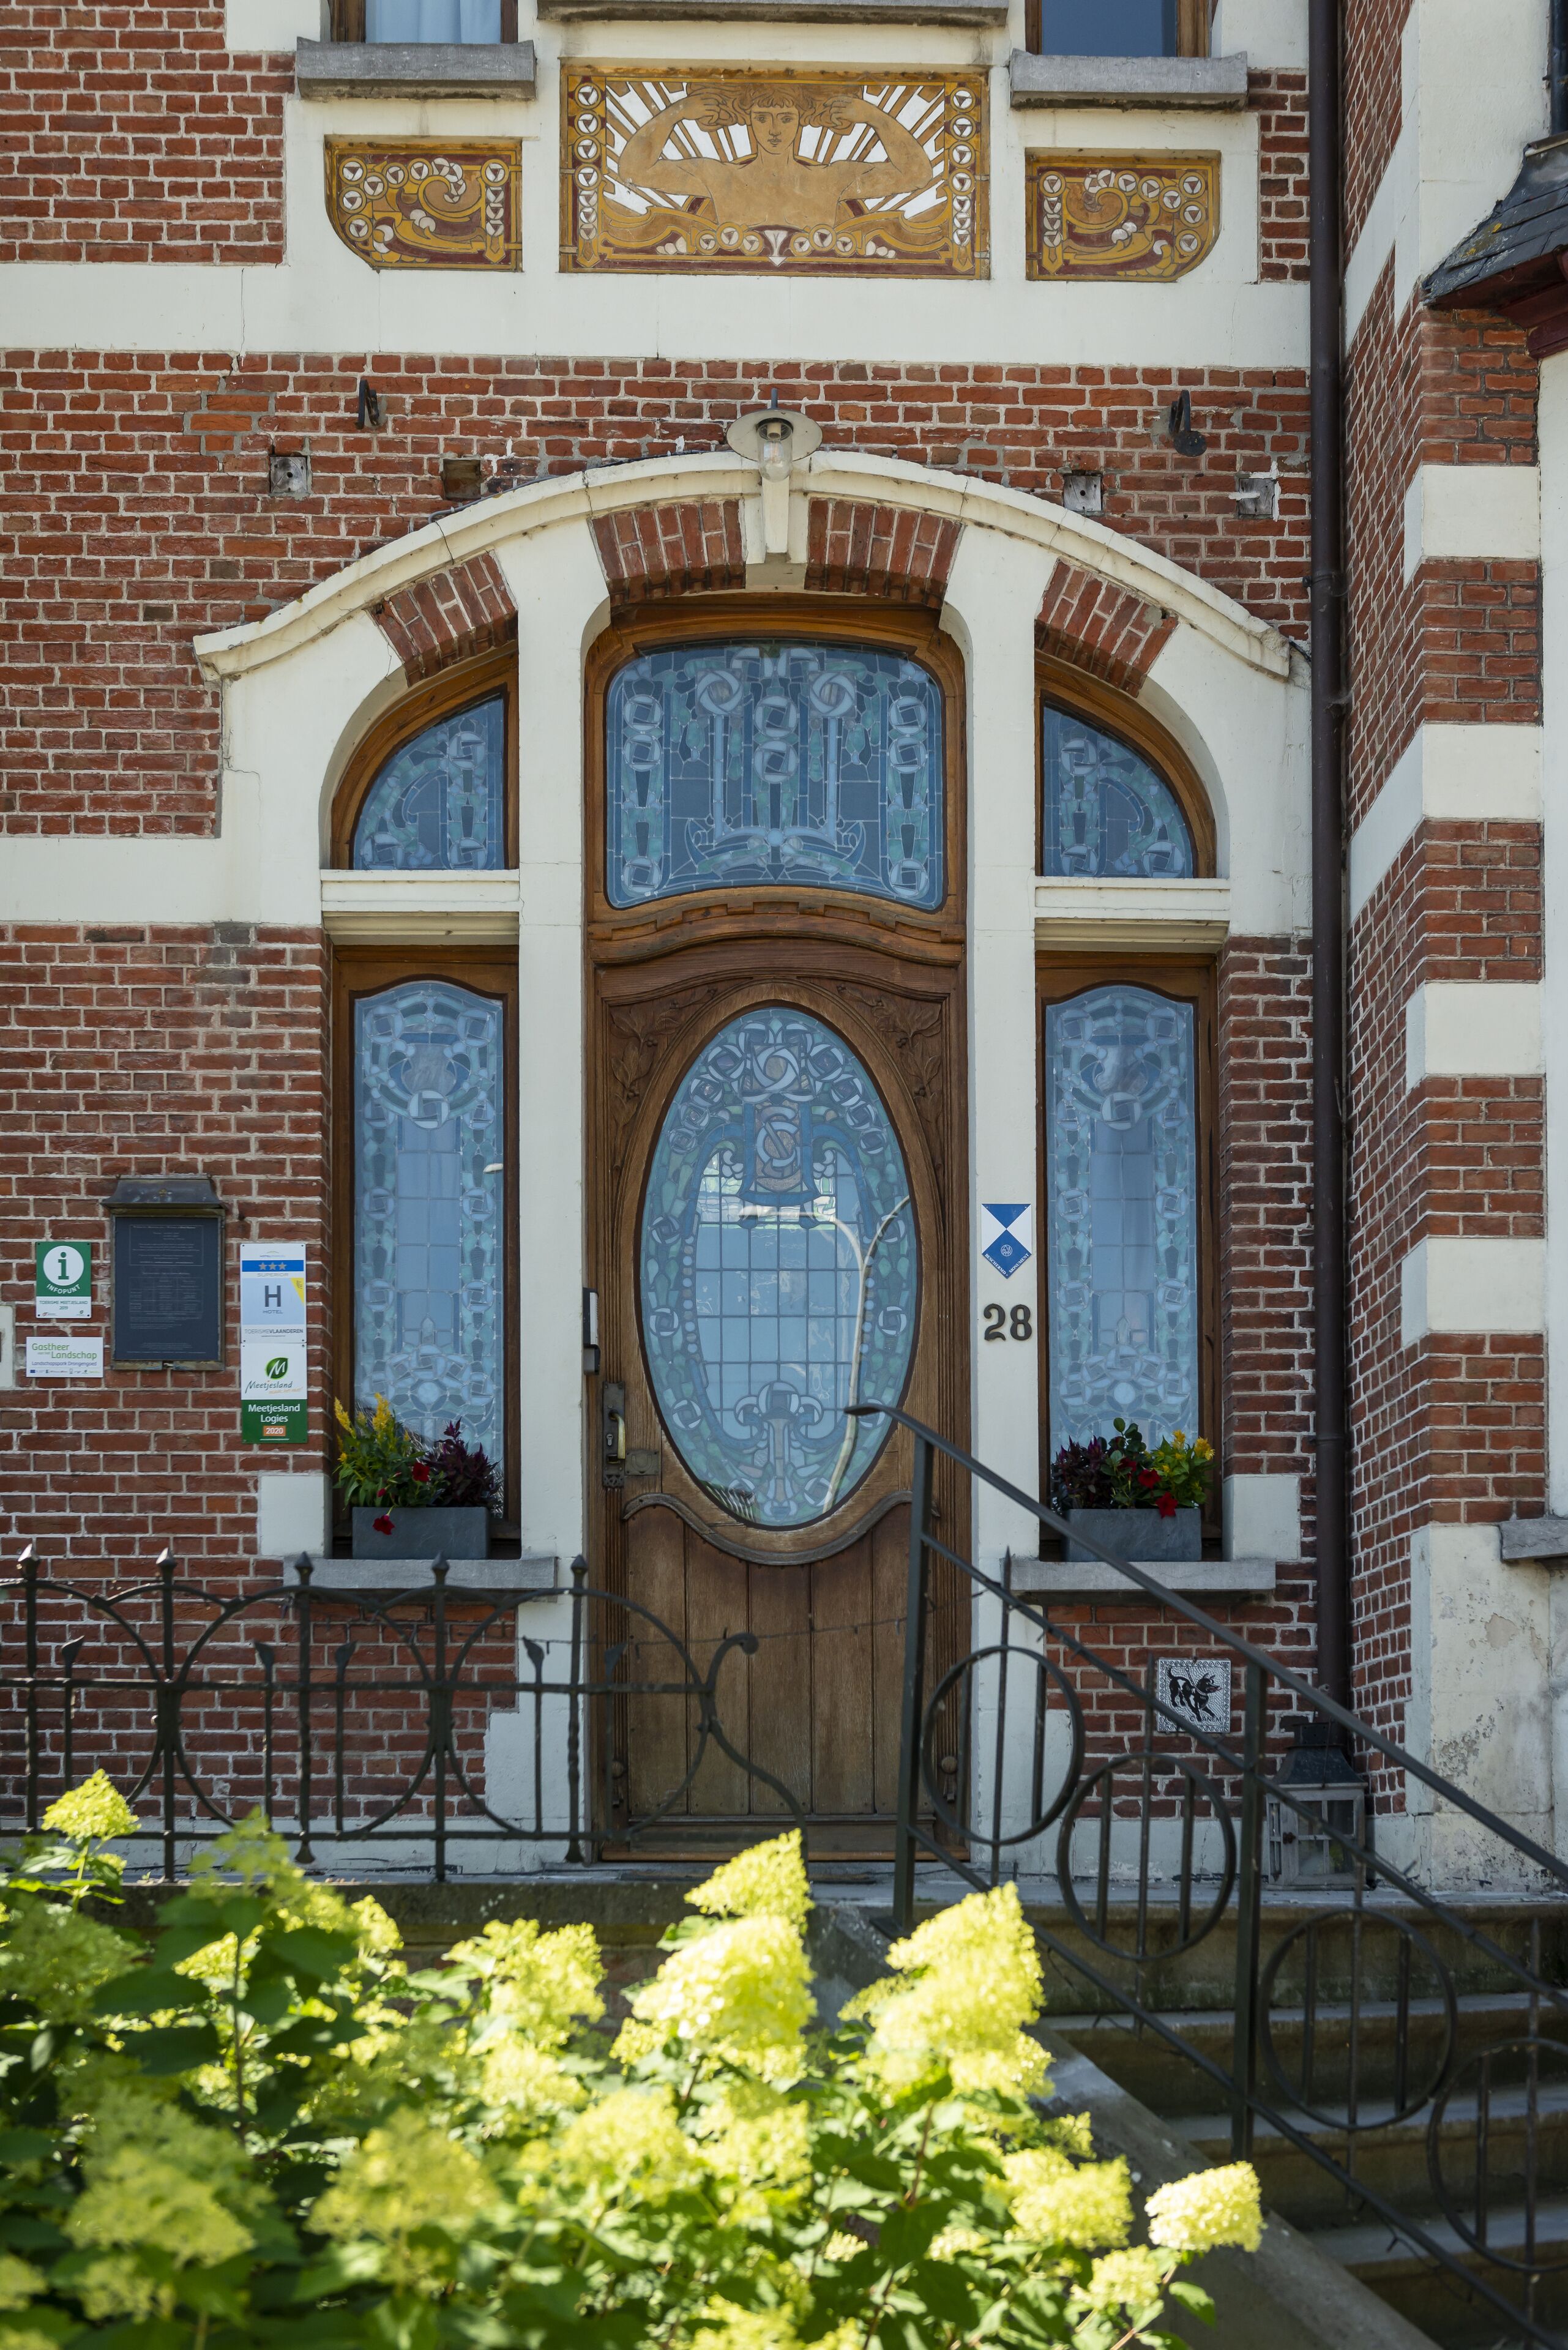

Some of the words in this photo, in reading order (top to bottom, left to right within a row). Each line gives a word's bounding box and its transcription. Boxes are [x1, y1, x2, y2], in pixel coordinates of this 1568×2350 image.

[984, 1253, 1007, 1275] BESCHERMD
[1008, 1253, 1029, 1274] MONUMENT
[47, 1283, 80, 1294] INFOPUNT
[264, 1285, 282, 1307] H
[983, 1302, 1033, 1342] 28
[51, 1351, 97, 1360] Landschap
[245, 1381, 293, 1394] Meetjesland
[248, 1403, 301, 1414] Meetjesland
[260, 1414, 289, 1425] Logies
